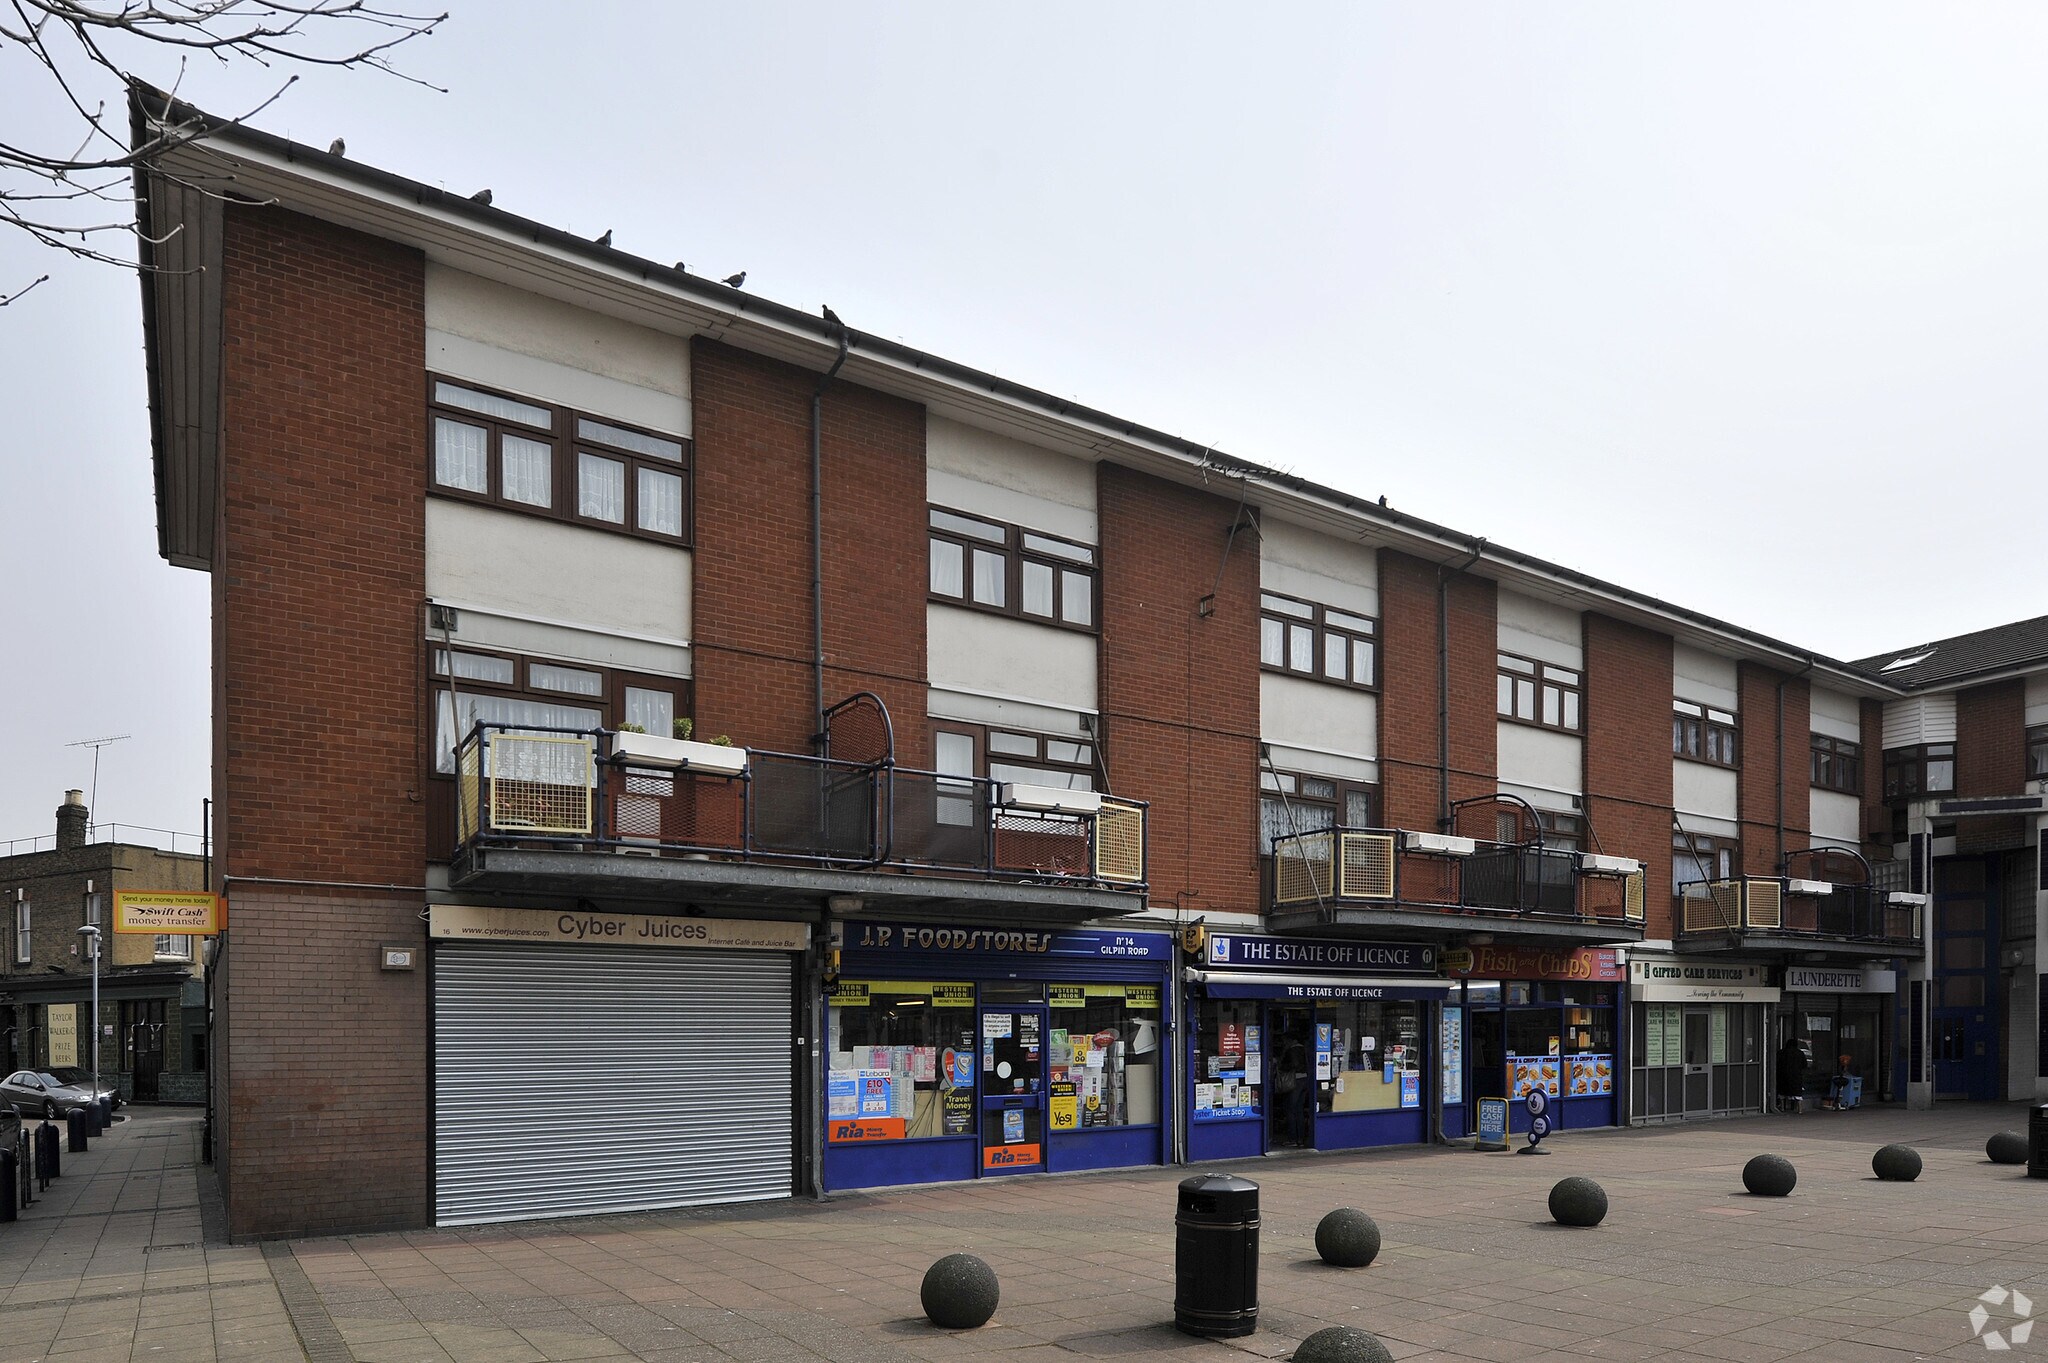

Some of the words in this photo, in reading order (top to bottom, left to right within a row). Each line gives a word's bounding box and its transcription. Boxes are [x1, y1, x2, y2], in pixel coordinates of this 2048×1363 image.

[193, 897, 211, 905] today!
[145, 907, 175, 916] Swift
[128, 917, 163, 927] money
[167, 917, 206, 926] transfer
[556, 914, 627, 940] Cyber
[637, 918, 708, 940] Juices
[443, 928, 451, 936] 16
[461, 926, 550, 938] www.cyberjuices.com
[707, 937, 734, 946] Internet
[765, 939, 783, 947] Juice
[784, 940, 796, 948] Bar
[859, 925, 893, 948] J.P.
[901, 926, 1052, 953] FOODSTORES
[1100, 945, 1126, 955] GILPIN
[1127, 946, 1149, 956] ROAD
[1242, 942, 1271, 960] THE
[1274, 943, 1324, 962] ESTATE
[1327, 946, 1353, 963] OFF
[1357, 947, 1410, 965] LICENCE
[1477, 946, 1518, 975] Fish
[1519, 959, 1536, 968] and
[1652, 966, 1682, 979] GIFTED
[1684, 967, 1705, 979] CARE
[1706, 968, 1743, 980] SERVICES
[1790, 971, 1862, 988] LAUNDERETTE
[1287, 986, 1304, 996] THE
[1306, 987, 1333, 997] ESTATE
[1334, 988, 1350, 997] OFF
[1351, 988, 1383, 998] LICENCE
[51, 1013, 73, 1021] TAYLOR
[54, 1042, 71, 1050] PRIZE
[55, 1054, 72, 1063] BEERS
[1506, 1056, 1518, 1064] FISH
[866, 1079, 883, 1088] £10
[948, 1094, 970, 1102] Travel
[945, 1102, 972, 1110] Money
[1481, 1104, 1503, 1113] FREE
[1053, 1111, 1072, 1126] Yes!
[1194, 1111, 1211, 1120] yster
[1212, 1109, 1231, 1117] Ticket
[1231, 1108, 1246, 1117] Stop
[1481, 1112, 1503, 1120] CASH
[836, 1121, 864, 1139] Ria
[1480, 1124, 1502, 1132] HERE
[990, 1147, 1015, 1165] Ria
